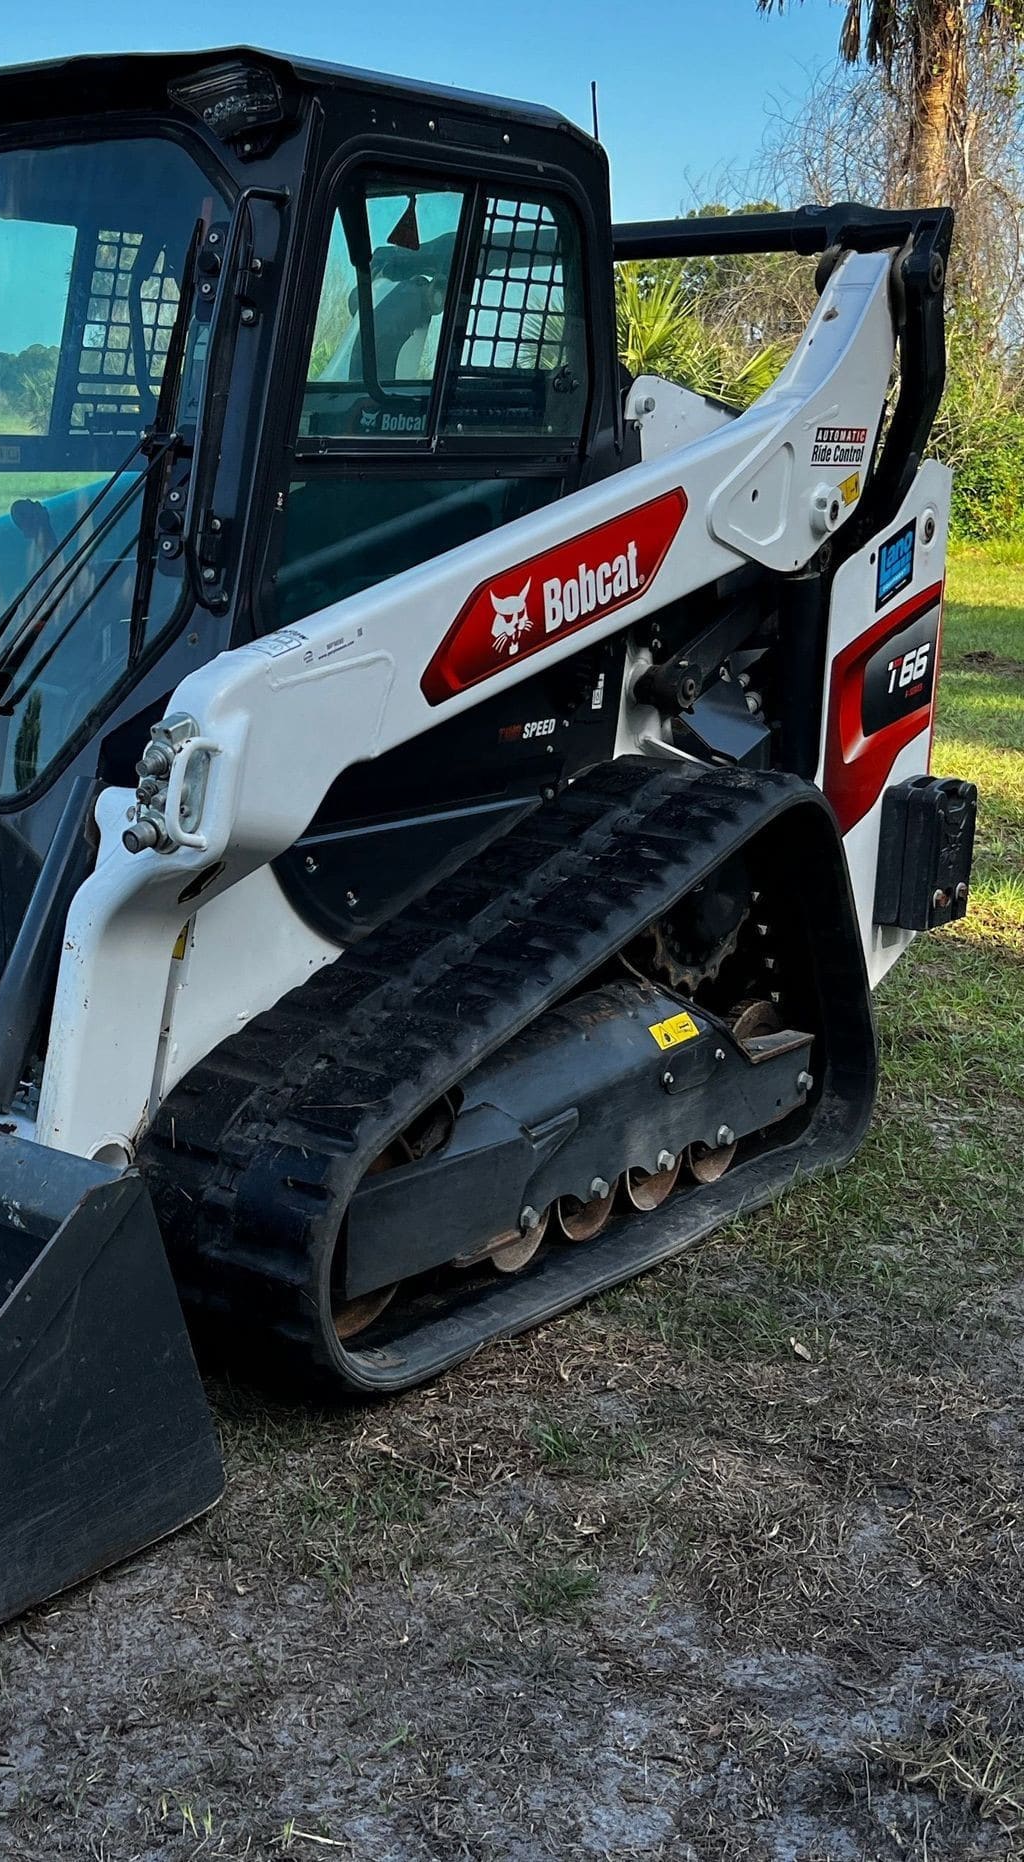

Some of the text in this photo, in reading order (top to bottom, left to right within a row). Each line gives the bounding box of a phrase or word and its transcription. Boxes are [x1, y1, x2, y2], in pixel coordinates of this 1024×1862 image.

[381, 413, 427, 431] Bobcat
[817, 429, 866, 442] AUTOMATIC
[811, 444, 865, 463] Ride Control
[542, 540, 639, 634] Bobcat
[887, 642, 930, 694] T66
[522, 718, 556, 739] SPEED
